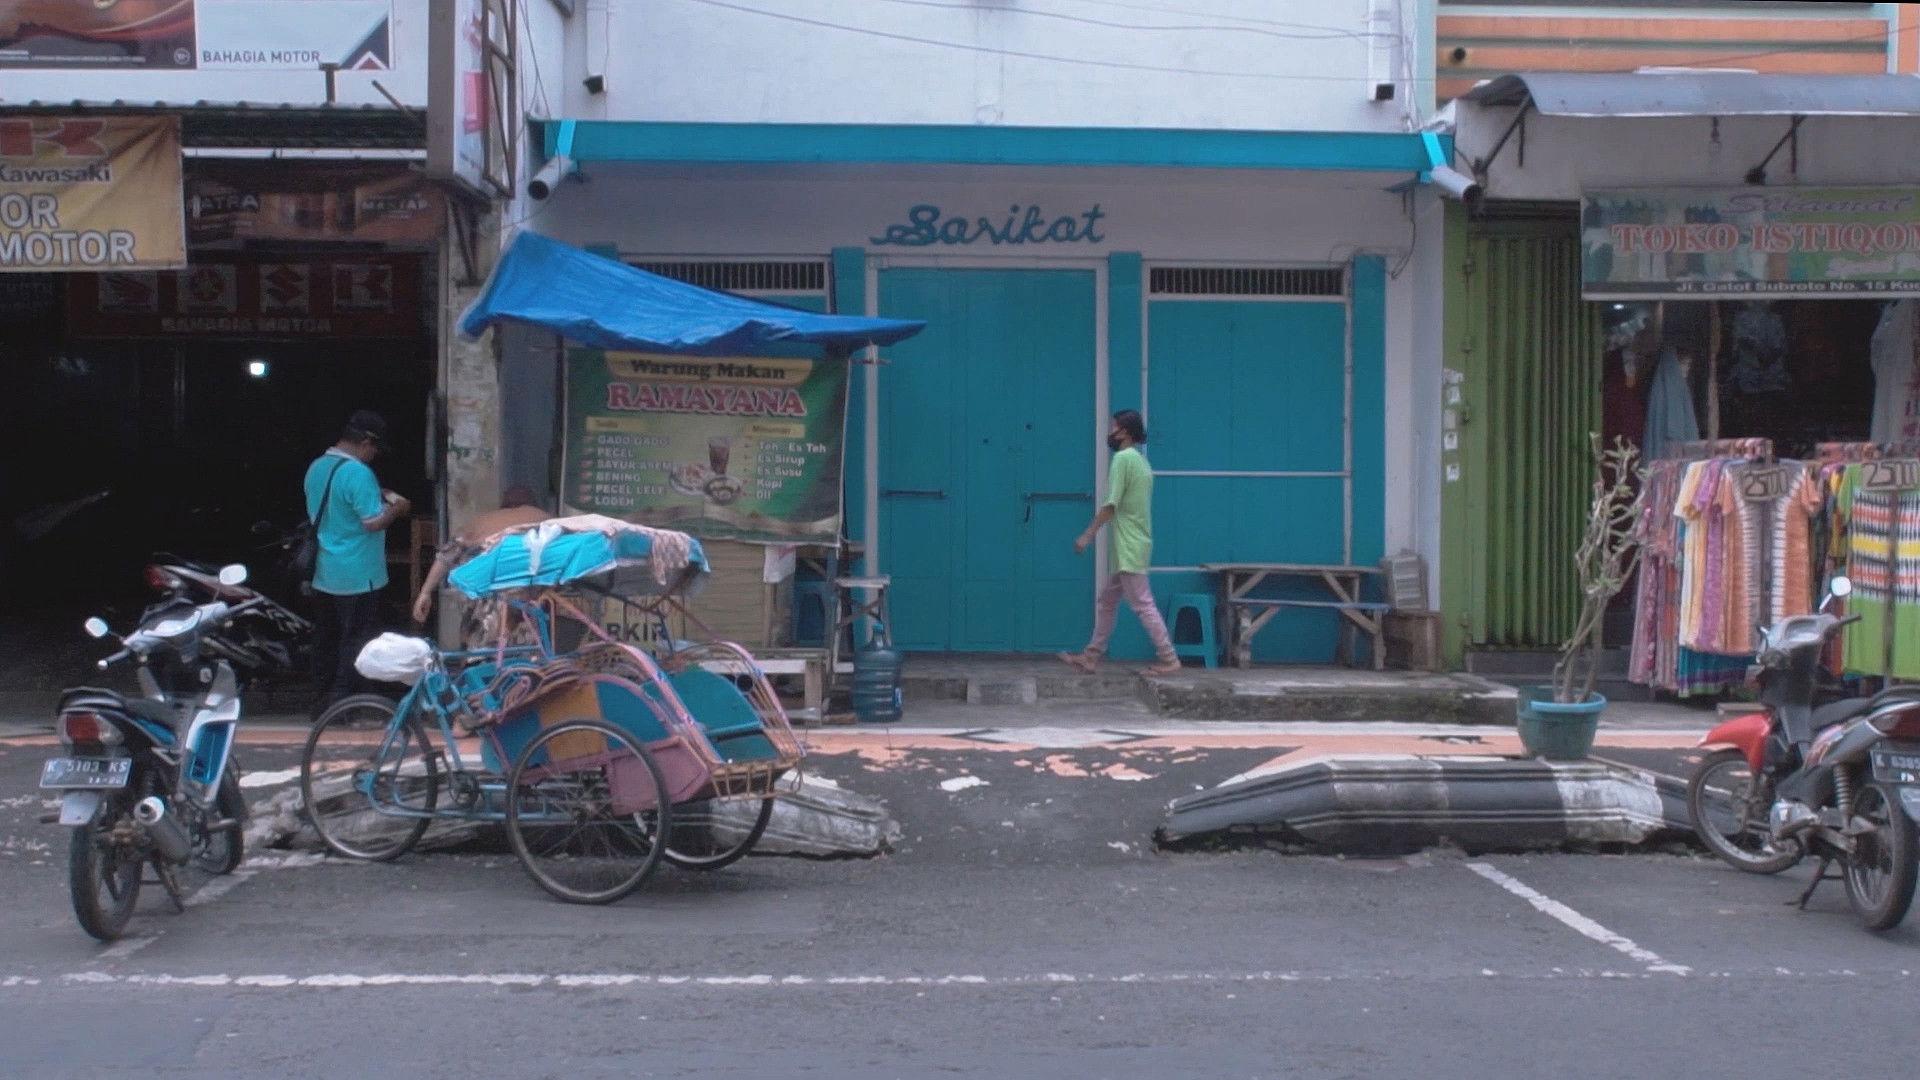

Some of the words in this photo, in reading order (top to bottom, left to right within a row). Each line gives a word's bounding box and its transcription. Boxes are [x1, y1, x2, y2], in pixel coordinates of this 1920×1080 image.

[202, 50, 266, 63] BAHAGIA
[271, 50, 320, 63] MOTOR
[868, 203, 1105, 246] Sarikat
[1610, 222, 1740, 253] TOKO
[1749, 221, 1920, 257] ISTIQO
[0, 230, 136, 266] MOTOR
[1755, 281, 1826, 292] Subroto
[630, 358, 711, 379] Warung
[716, 364, 785, 379] Makan
[607, 382, 807, 416] RAMAYANA
[806, 443, 826, 453] Teh
[775, 454, 805, 467] Sirup
[775, 466, 802, 477] Susu
